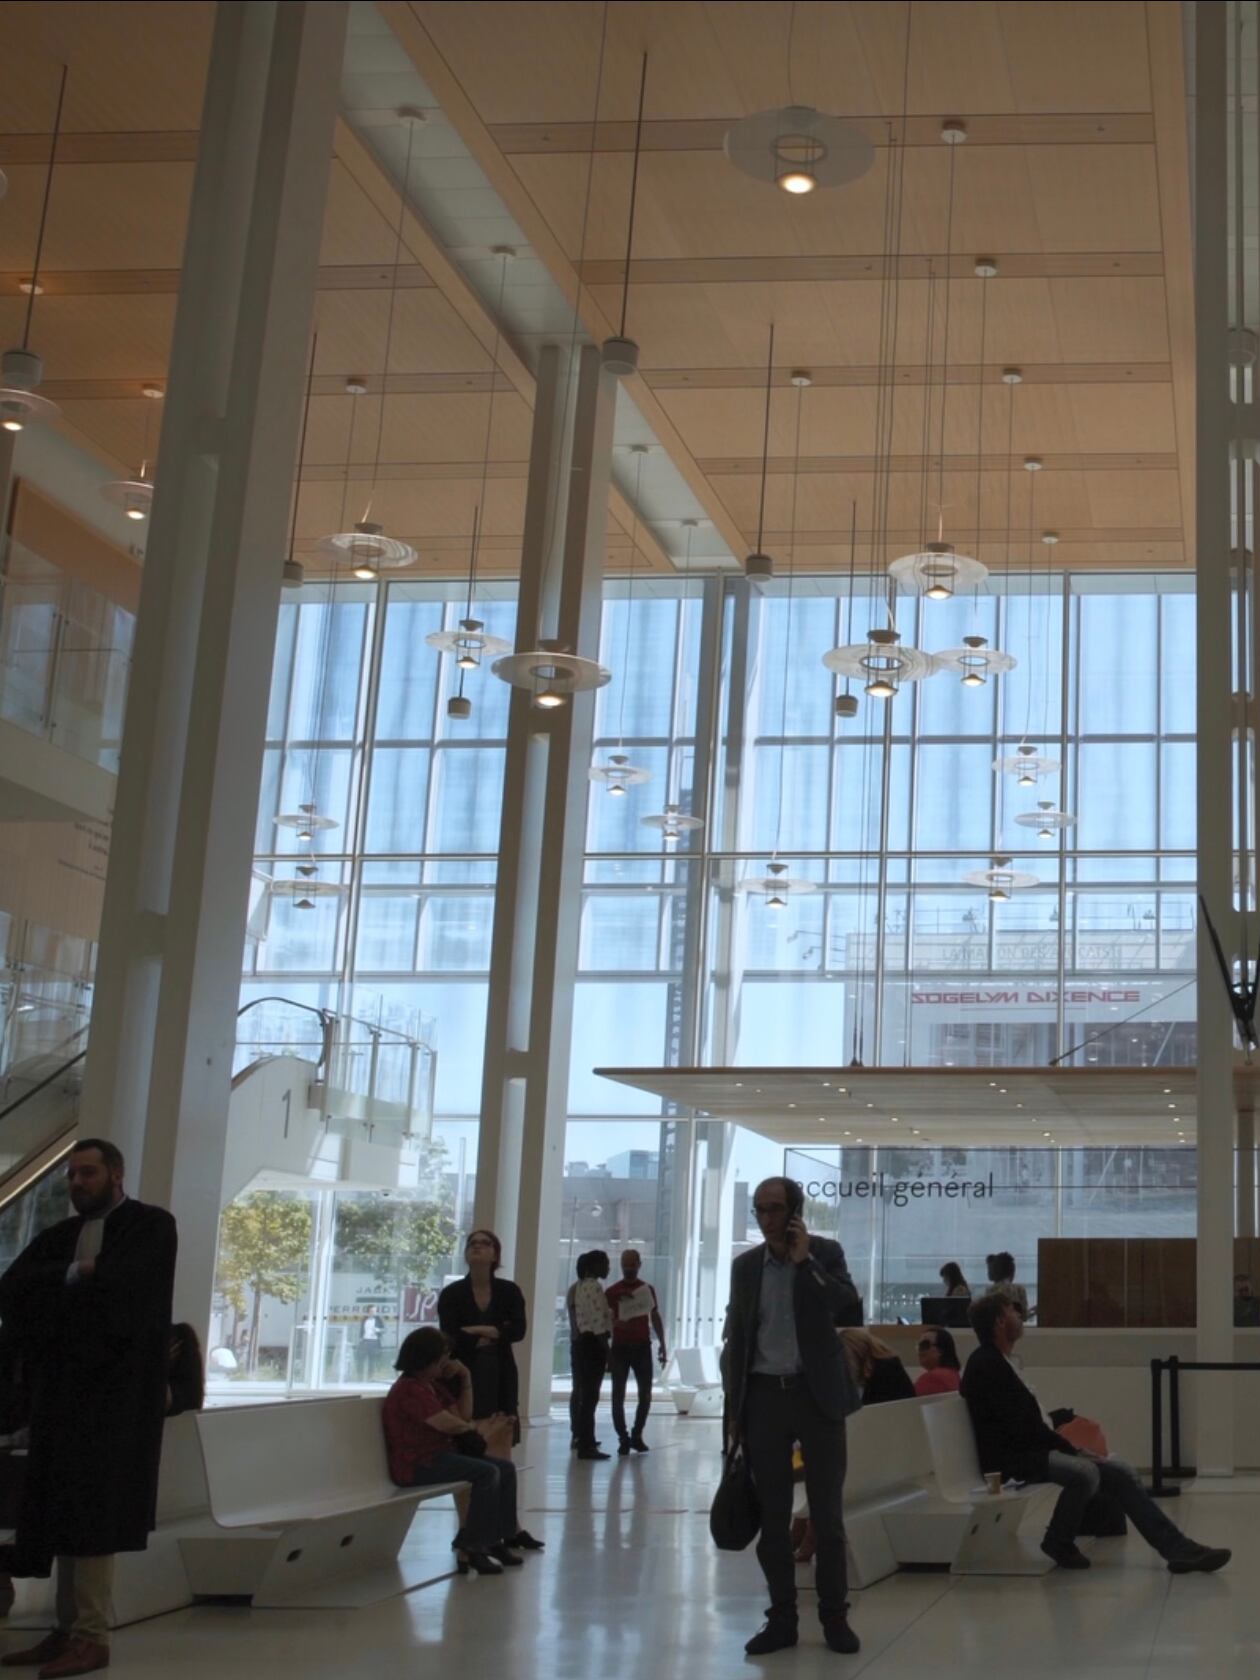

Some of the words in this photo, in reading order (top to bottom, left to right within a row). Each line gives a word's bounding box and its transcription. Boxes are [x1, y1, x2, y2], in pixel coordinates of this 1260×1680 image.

[911, 991, 1019, 1004] SOGELYM
[1026, 990, 1141, 1004] DIXENCE
[282, 1088, 291, 1139] 1
[893, 1171, 993, 1208] général
